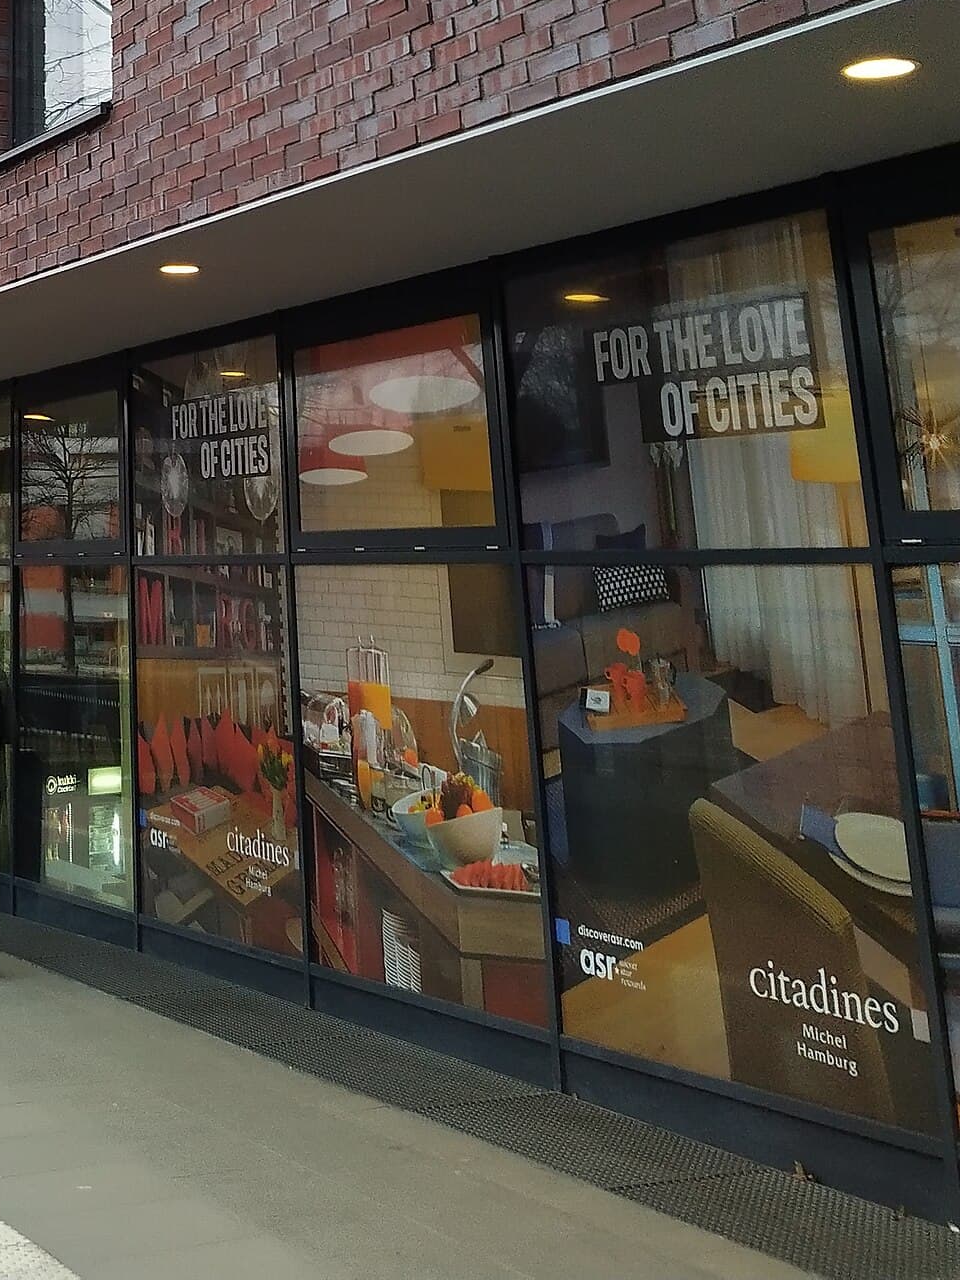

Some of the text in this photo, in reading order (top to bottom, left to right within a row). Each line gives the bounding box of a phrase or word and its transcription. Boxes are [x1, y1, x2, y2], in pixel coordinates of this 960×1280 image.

[593, 298, 811, 382] FOR THE LOVE
[171, 390, 268, 441] FOR THE LOVE
[660, 366, 819, 437] OF CITIES
[200, 434, 269, 479] OF CITIES
[150, 827, 167, 849] asr
[227, 826, 290, 867] citadines
[248, 865, 268, 880] Michel
[578, 924, 644, 952] discoverasr.com
[580, 948, 616, 980] asr
[749, 960, 900, 1034] citadines
[802, 1023, 847, 1050] Michel
[796, 1041, 859, 1078] Hamburg
